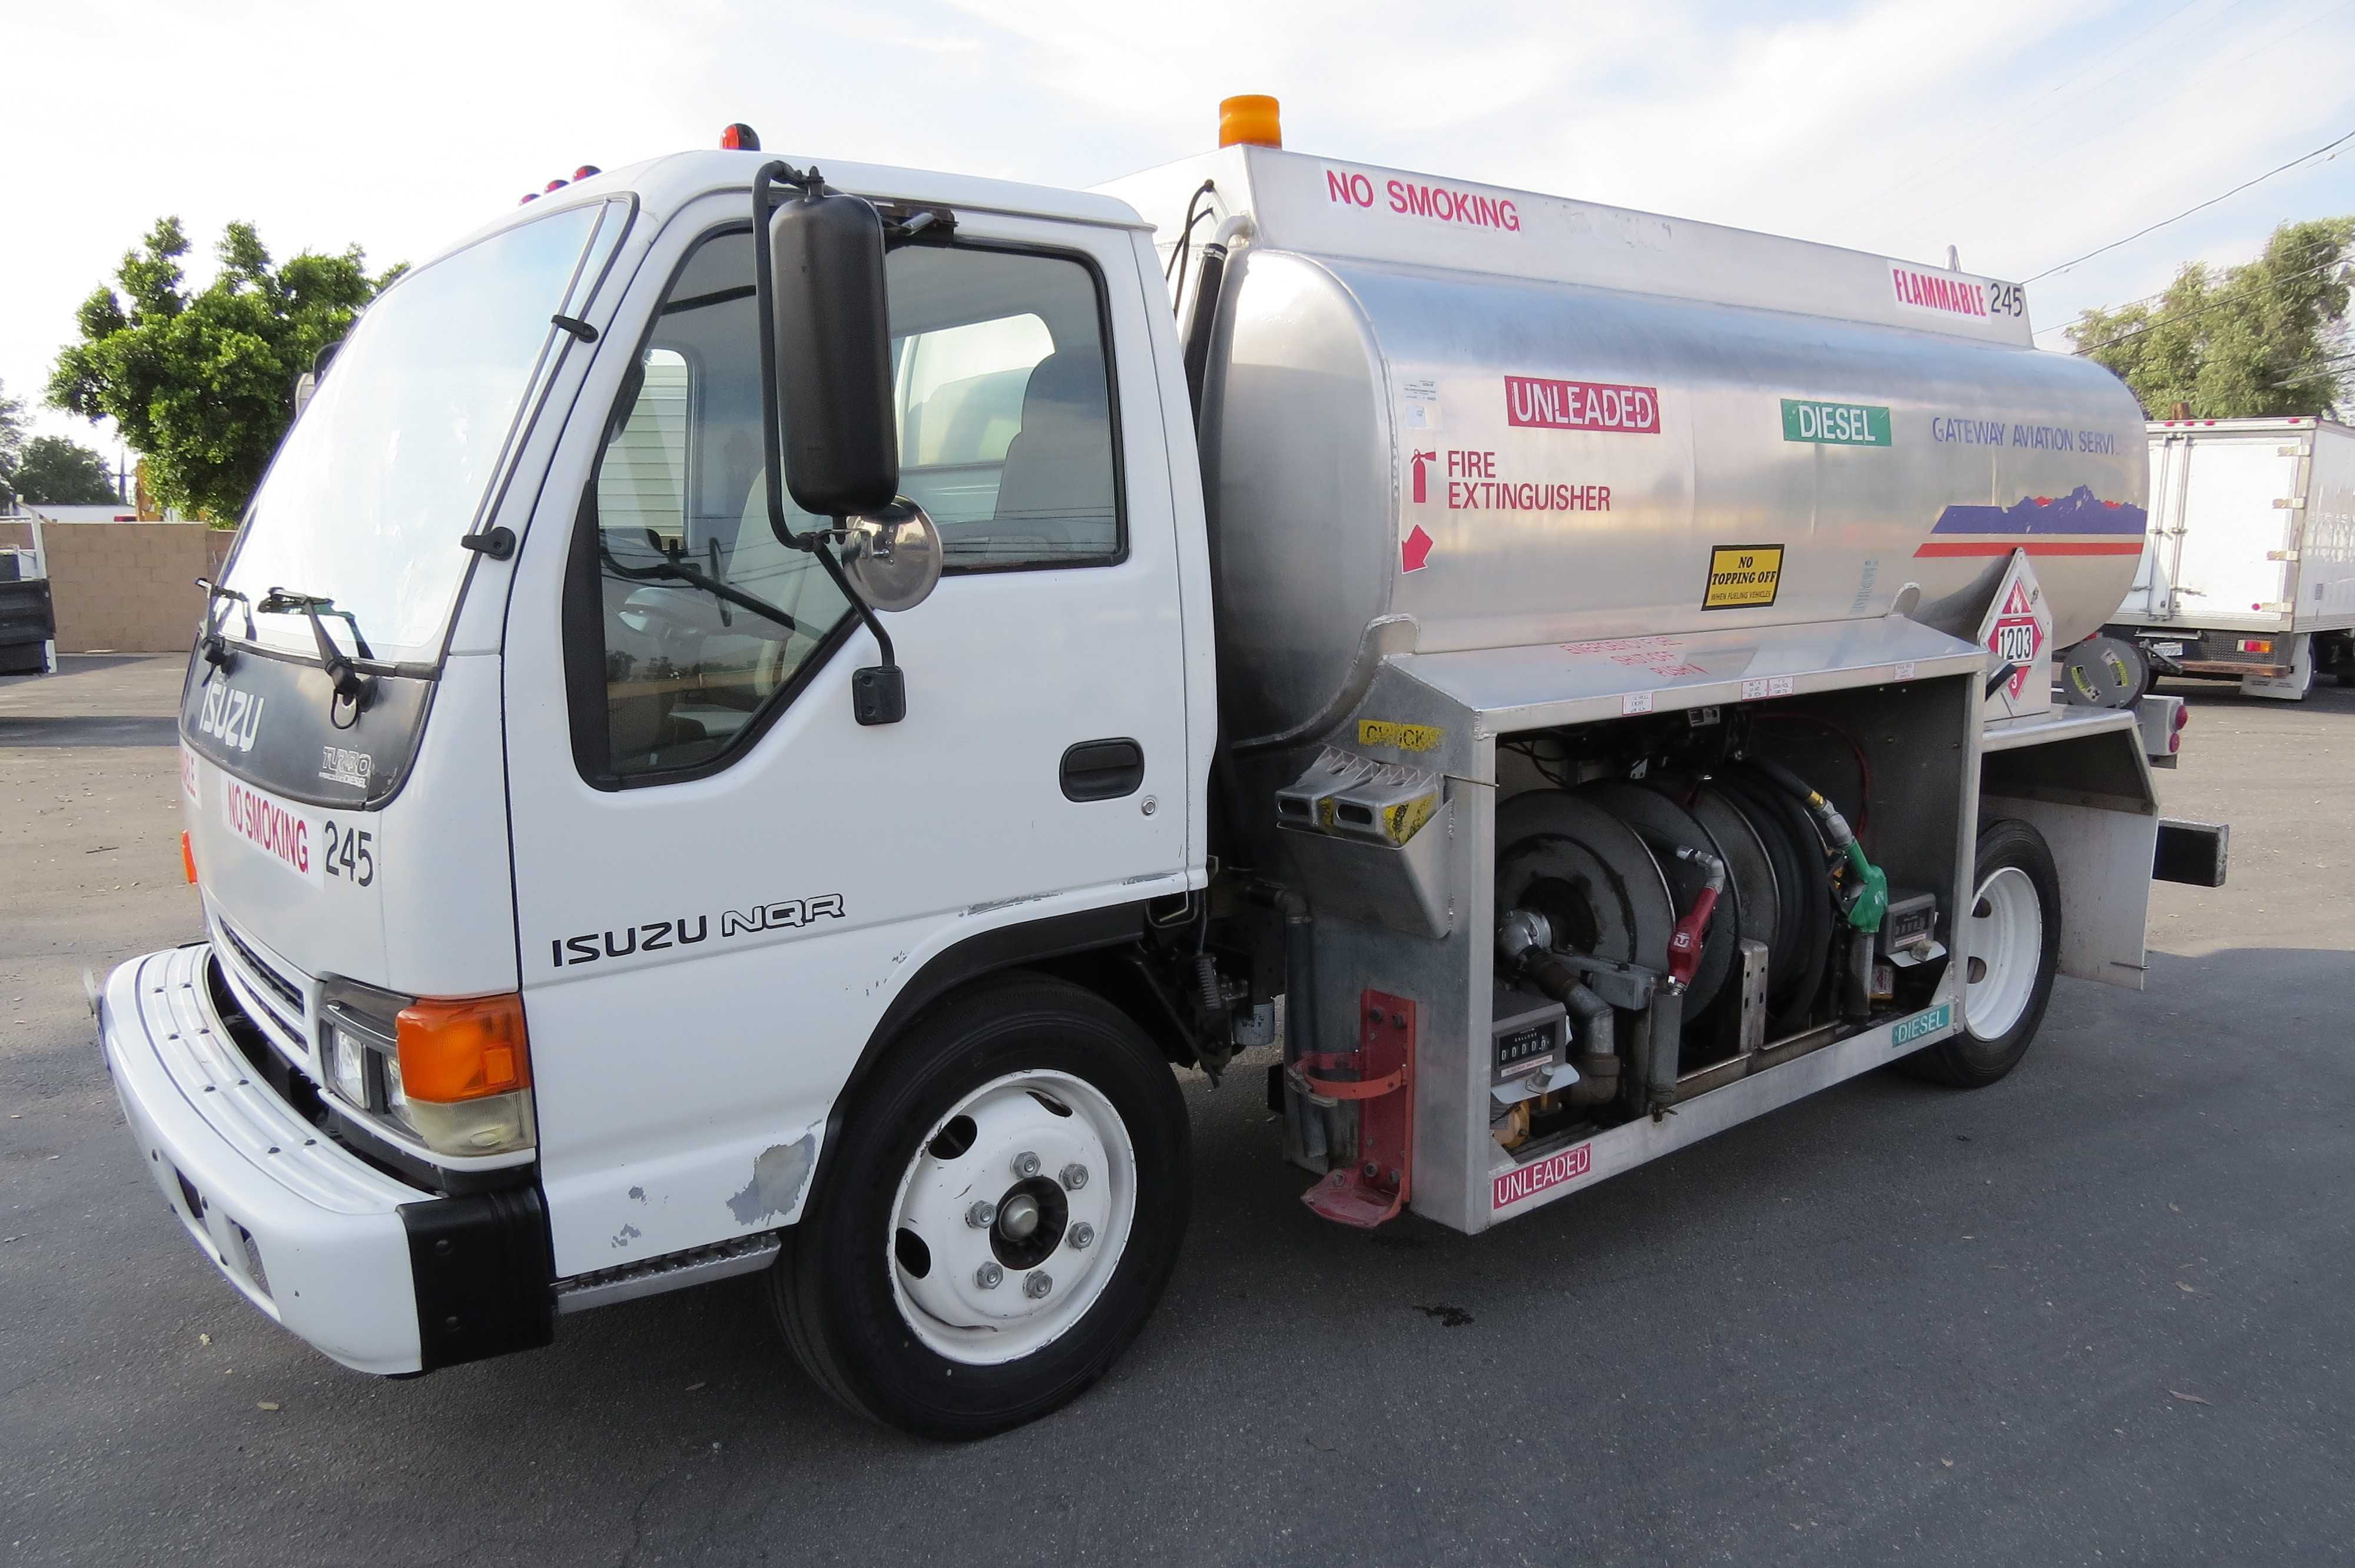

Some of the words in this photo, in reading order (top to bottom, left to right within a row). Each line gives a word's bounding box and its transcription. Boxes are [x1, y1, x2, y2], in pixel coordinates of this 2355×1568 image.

[1326, 170, 1374, 208] NO
[1387, 180, 1520, 232] SMOKING
[1893, 268, 1986, 317] FLAMMABLE
[1991, 283, 2022, 317] 245
[1512, 381, 1653, 428] UNLEADED
[1799, 405, 1876, 441] DIESEL
[1932, 417, 2005, 446] GATEWAY
[2012, 424, 2074, 451] AVIATION
[1448, 450, 1496, 478] FIRE
[1448, 482, 1611, 511] EXTINGUISHER
[1711, 572, 1756, 585] TOPPING
[1757, 571, 1776, 583] OFF
[1738, 556, 1753, 569] NO
[1727, 591, 1749, 599] FUELING
[2001, 626, 2031, 660] 1203
[2011, 672, 2018, 689] 3
[199, 680, 264, 753] ISUZU
[323, 746, 372, 777] TURBO
[228, 781, 243, 833] NO
[245, 790, 309, 875] SMOKING
[325, 820, 374, 888] 245
[552, 915, 707, 967] ISUZU
[721, 893, 846, 938] NQR
[1898, 1010, 1943, 1043] DIESEL
[1498, 1149, 1588, 1204] UNLEADED
